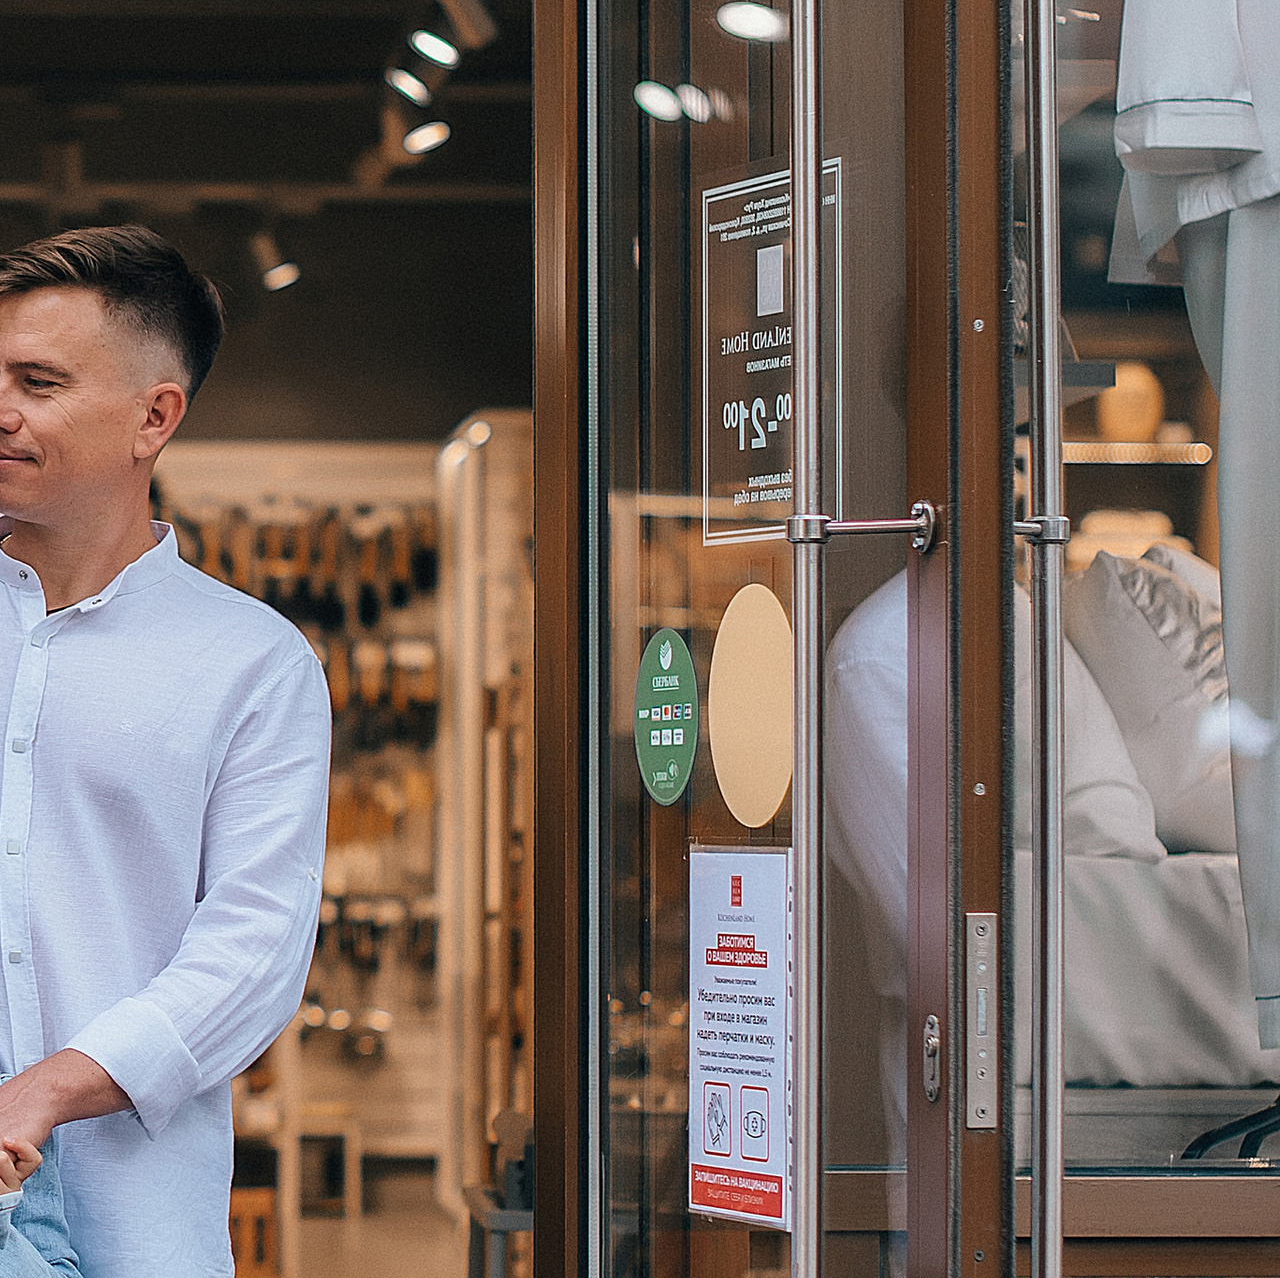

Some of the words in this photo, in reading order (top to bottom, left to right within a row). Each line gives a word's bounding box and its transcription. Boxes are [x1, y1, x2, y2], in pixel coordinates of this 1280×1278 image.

[653, 676, 679, 687] СБЕРБАНК
[719, 936, 754, 948] ЗАБОТИМСЯ
[708, 951, 712, 961] О
[713, 952, 734, 963] ВАШЕМ
[735, 952, 766, 965] ЗДОРОВЬЕ
[698, 988, 737, 1004] Убедительно
[739, 994, 762, 1008] просим
[764, 996, 775, 1006] вас
[704, 1011, 715, 1023] при
[717, 1012, 735, 1024] входе
[736, 1014, 740, 1023] в
[742, 1014, 768, 1025] магазин
[697, 1030, 717, 1040] надеть
[719, 1032, 748, 1045] перчатки
[750, 1034, 754, 1043] и
[755, 1035, 775, 1049] маску.
[695, 1171, 730, 1186] ЗАПИШИТЕСЬ
[731, 1176, 738, 1186] НА
[739, 1178, 779, 1193] ВАКЦИНАЦИЮ
